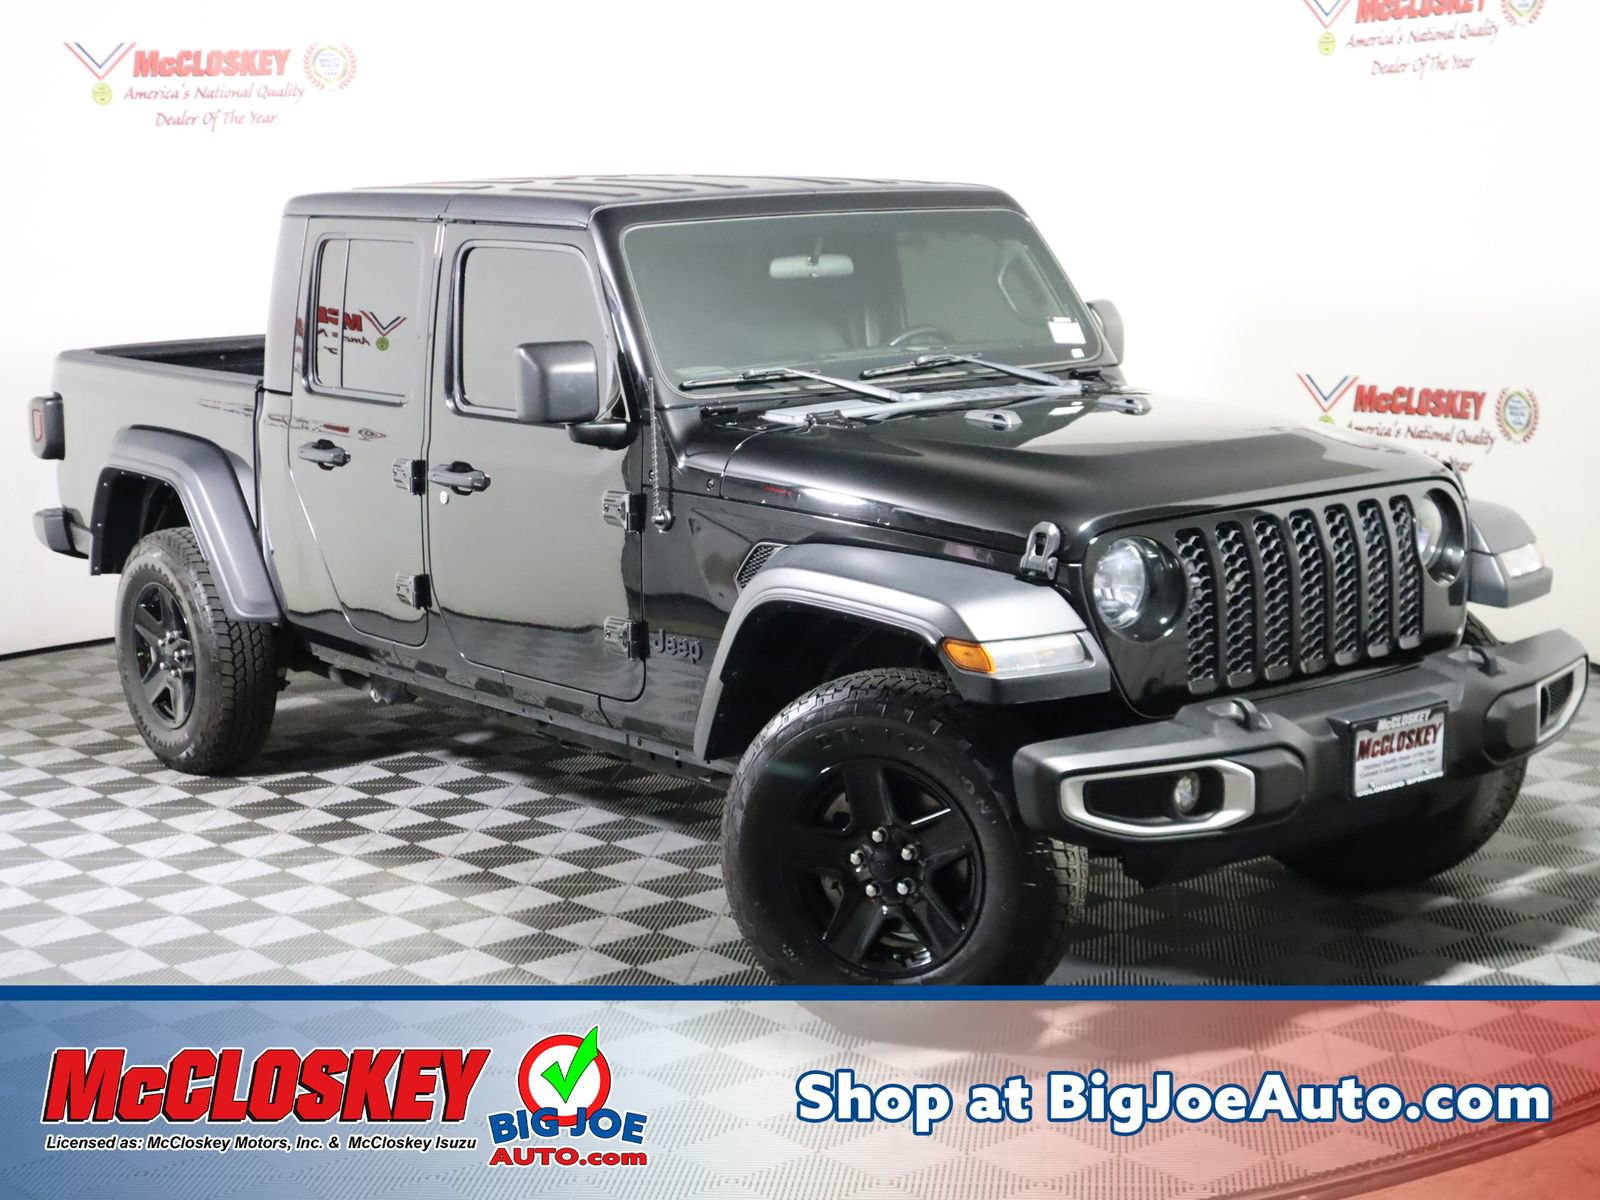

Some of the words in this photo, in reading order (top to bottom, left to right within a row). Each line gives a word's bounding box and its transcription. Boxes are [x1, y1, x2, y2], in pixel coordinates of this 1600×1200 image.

[1346, 27, 1404, 49] America's
[1408, 21, 1458, 44] National
[1460, 18, 1500, 46] Quality
[133, 49, 291, 77] McCLOSKEY
[1370, 55, 1410, 76] Dealer
[123, 83, 190, 101] America's
[194, 82, 254, 100] National
[257, 81, 305, 105] Quality
[155, 109, 198, 127] Dealer
[202, 109, 221, 132] Of
[222, 108, 246, 125] The
[248, 110, 278, 126] Year
[1353, 383, 1487, 421] McCLOSKEY
[1405, 424, 1456, 443] National
[1456, 427, 1497, 455] Quality
[655, 628, 703, 665] Jeep
[1357, 722, 1444, 761] McCLOSKEY
